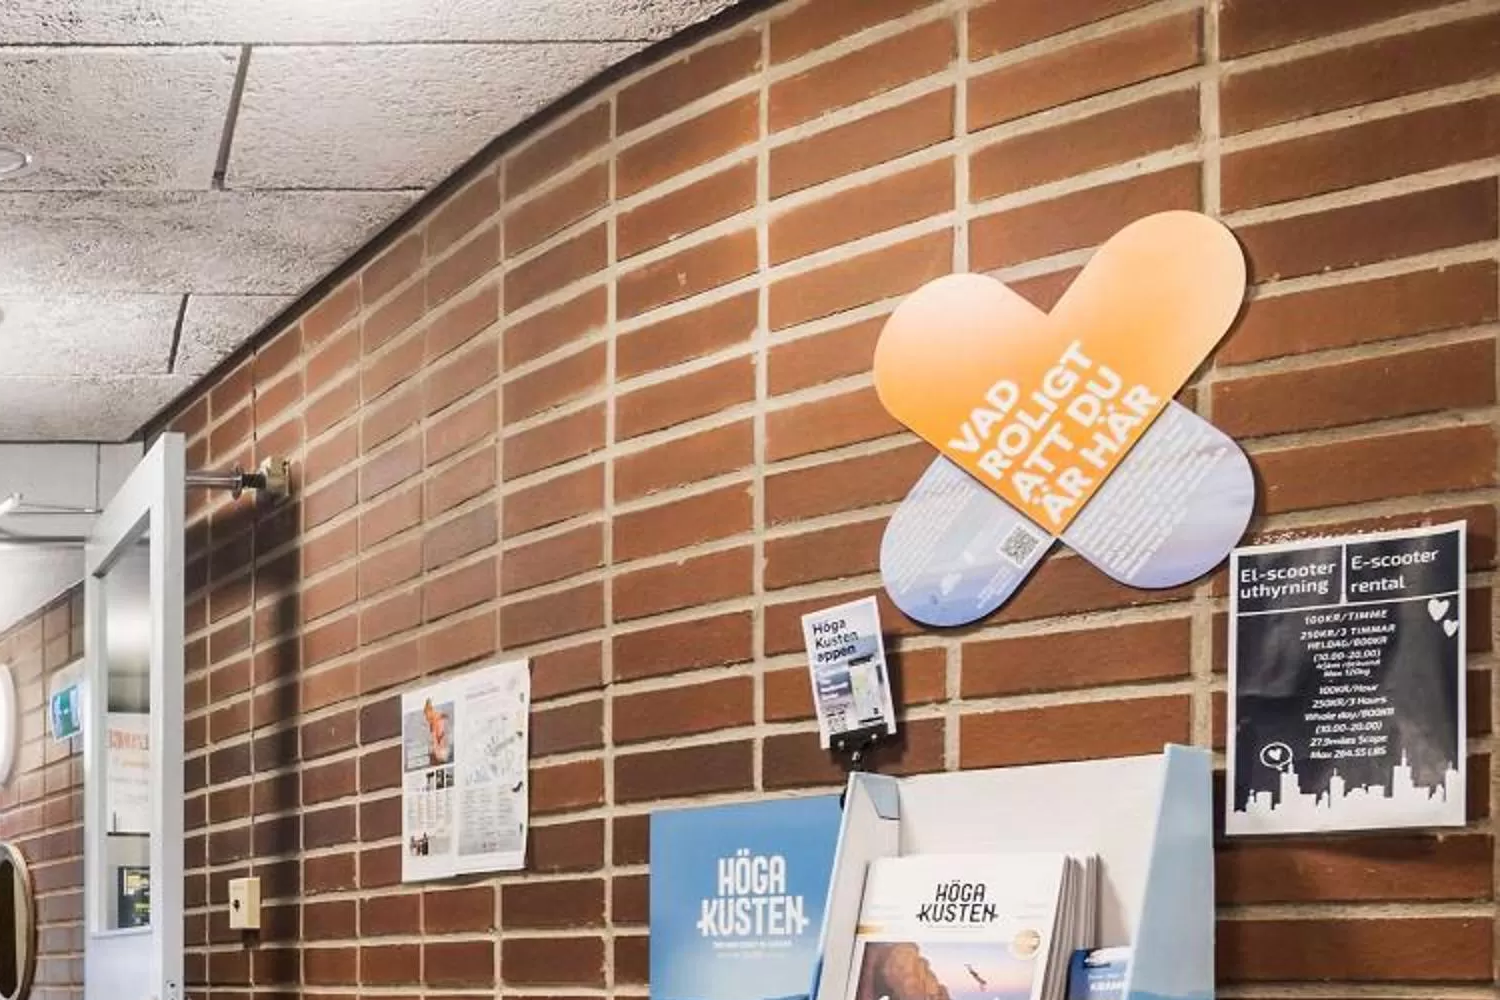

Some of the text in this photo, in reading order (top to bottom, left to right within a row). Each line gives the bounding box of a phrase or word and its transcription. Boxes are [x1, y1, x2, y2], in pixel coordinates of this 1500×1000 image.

[947, 379, 1020, 453] VAD
[977, 339, 1093, 480] ROLIGT
[1011, 364, 1123, 503] ATT DU
[1031, 466, 1093, 525] ÄR
[1079, 384, 1161, 469] HÄR
[1350, 549, 1440, 571] E-scooter
[1240, 561, 1337, 583] El-scooter
[1240, 578, 1330, 599] uthyrning
[1350, 575, 1405, 593] rental
[812, 618, 846, 634] Höga
[1304, 609, 1389, 625] 100KR/TIMME
[814, 630, 859, 650] Kusten
[1300, 623, 1396, 641] 250KR/3 TIMMAR
[816, 644, 857, 663] appen
[1357, 696, 1387, 705] Hours
[717, 847, 786, 896] HÖGA
[935, 880, 986, 902] HÖGA
[696, 895, 809, 937] KUSTEN
[915, 903, 999, 923] KUSTEN
